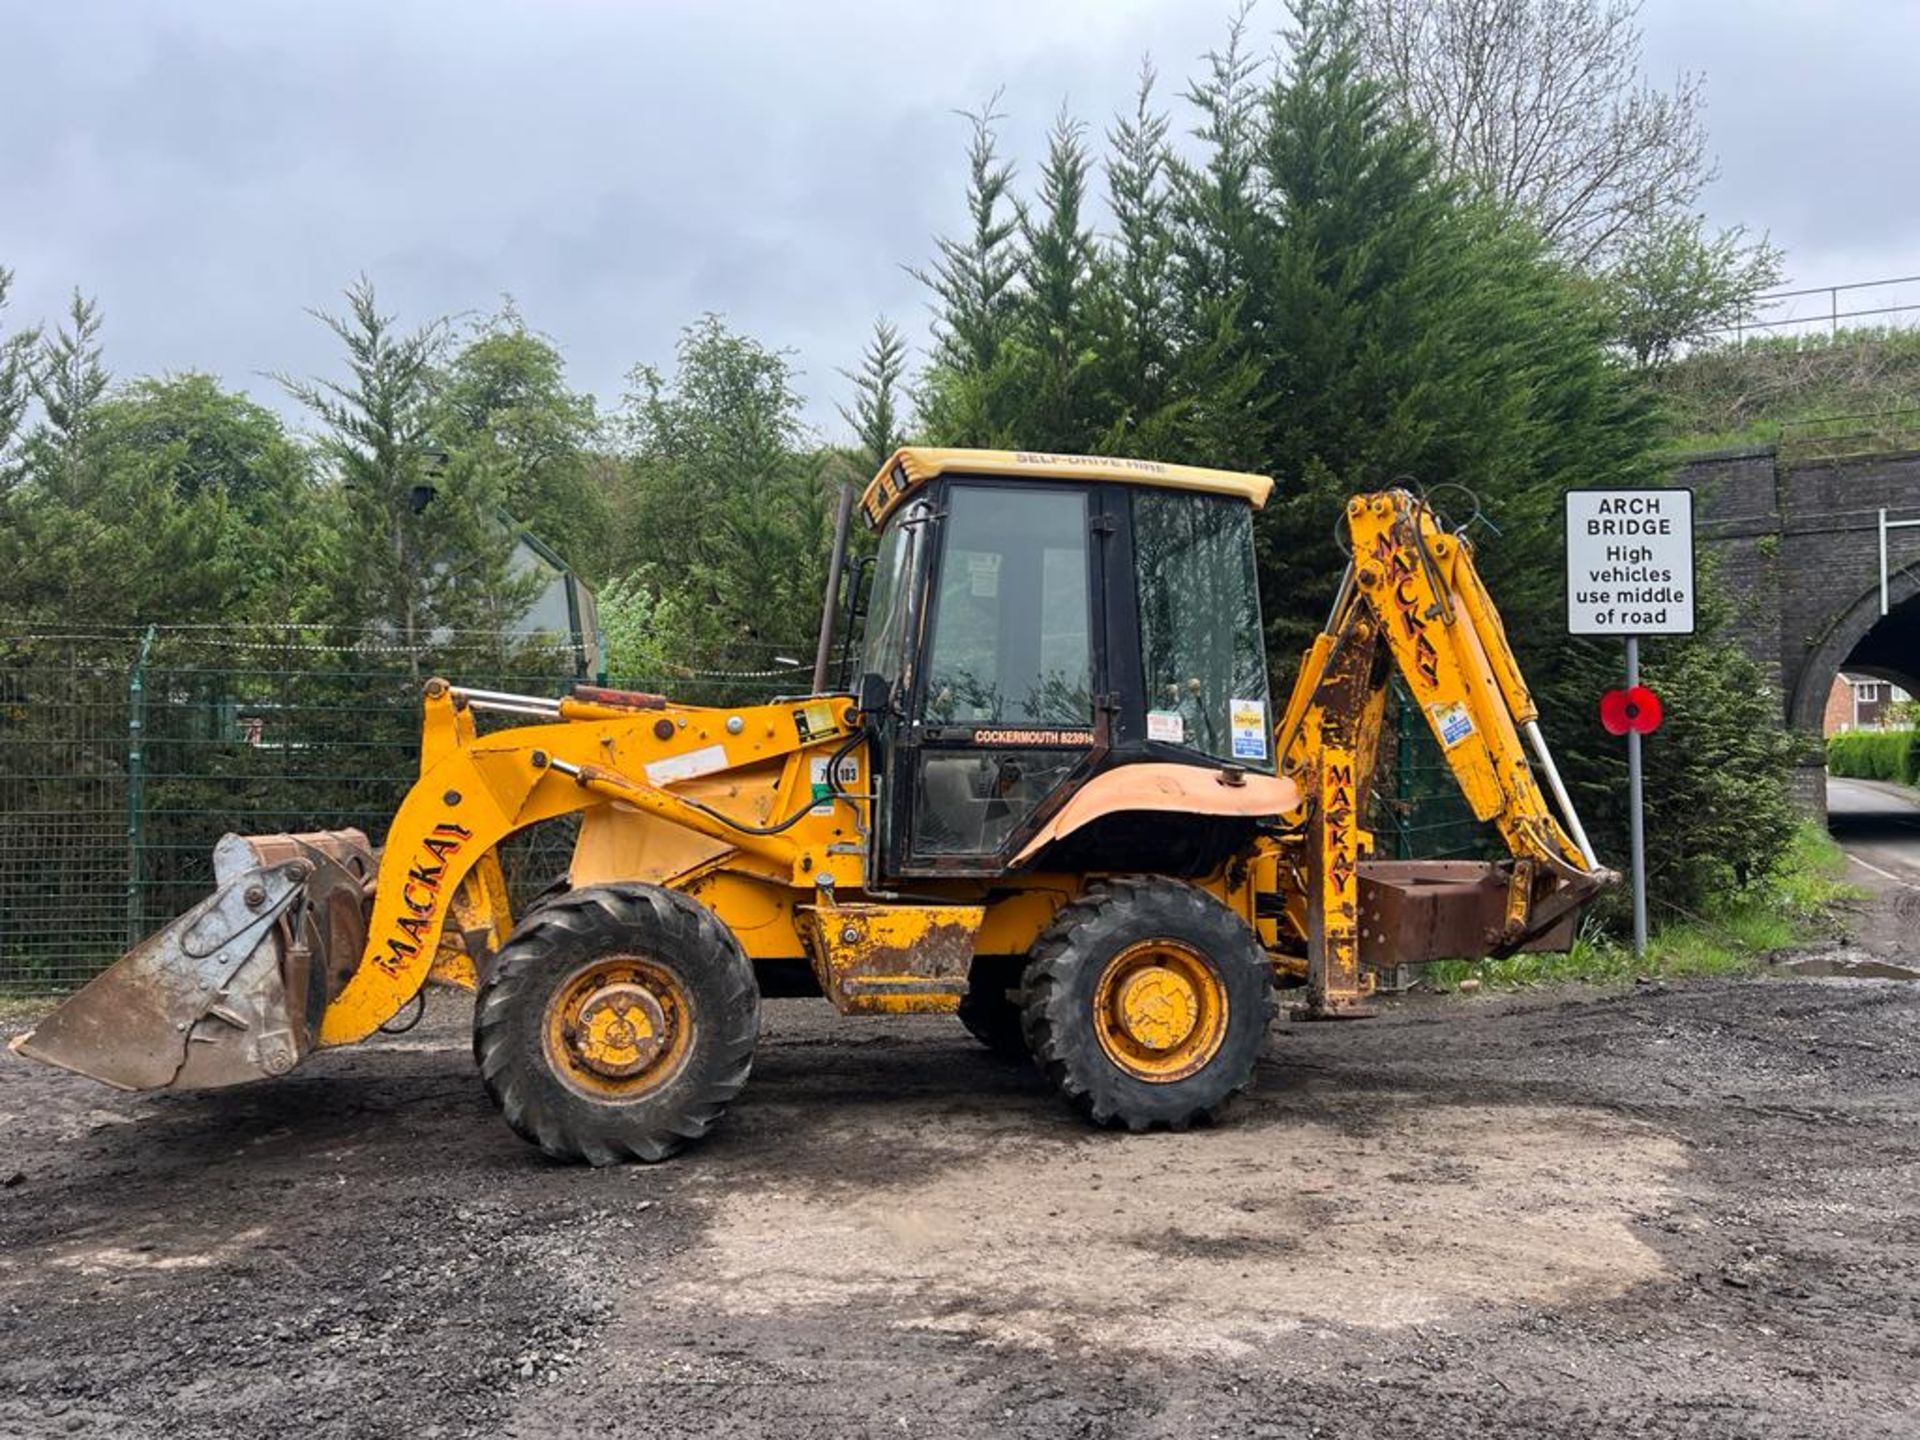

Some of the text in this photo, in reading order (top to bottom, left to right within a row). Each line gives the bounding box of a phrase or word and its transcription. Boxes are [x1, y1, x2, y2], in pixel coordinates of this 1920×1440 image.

[1016, 453, 1166, 473] SELF-DRIVE HIRE
[1598, 498, 1661, 515] ARCH
[1587, 519, 1671, 536] BRIDGE
[1606, 545, 1653, 564] High
[1589, 566, 1672, 583] vehicles
[1576, 587, 1684, 603] use middle
[1595, 608, 1667, 624] of road
[975, 730, 1058, 744] COCKERMOUTH
[1328, 764, 1353, 895] MACKAY
